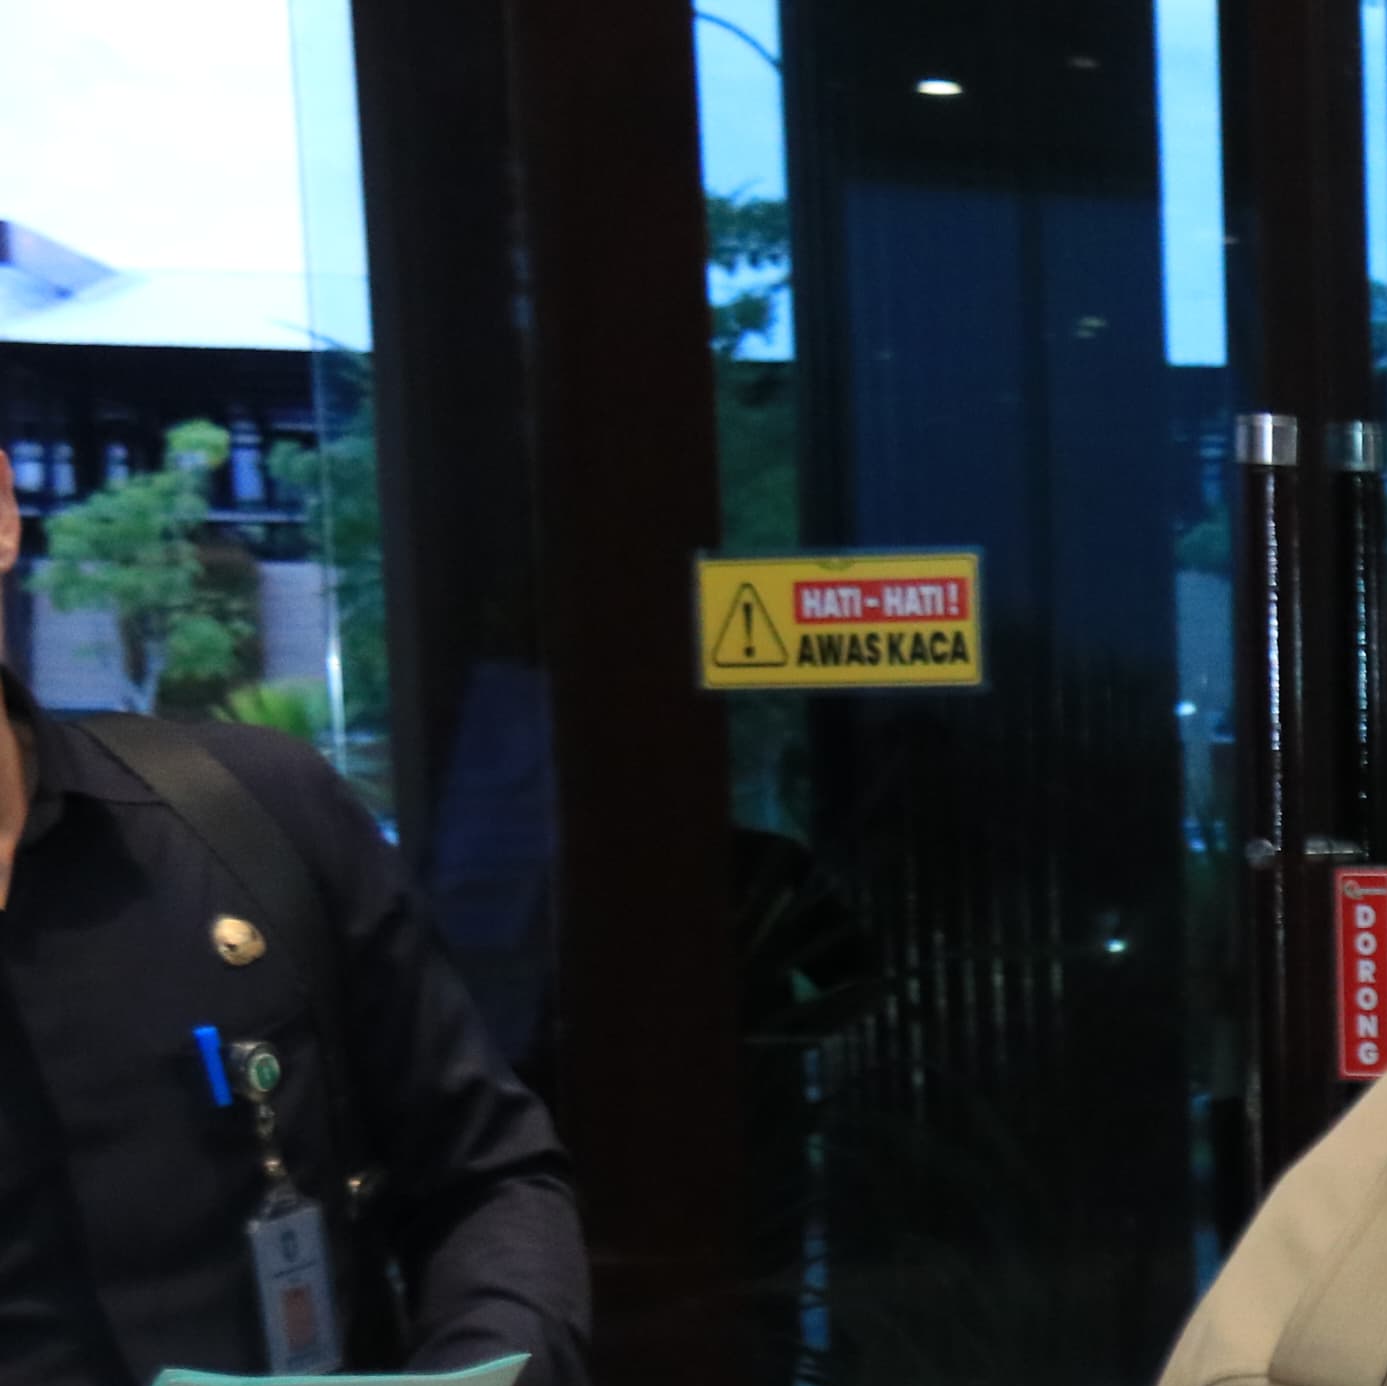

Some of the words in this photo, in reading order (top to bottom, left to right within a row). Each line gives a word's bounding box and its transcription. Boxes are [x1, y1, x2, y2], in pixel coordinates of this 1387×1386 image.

[797, 632, 881, 667] AWAS
[887, 630, 970, 666] KACA
[1354, 904, 1380, 1066] DORONG
